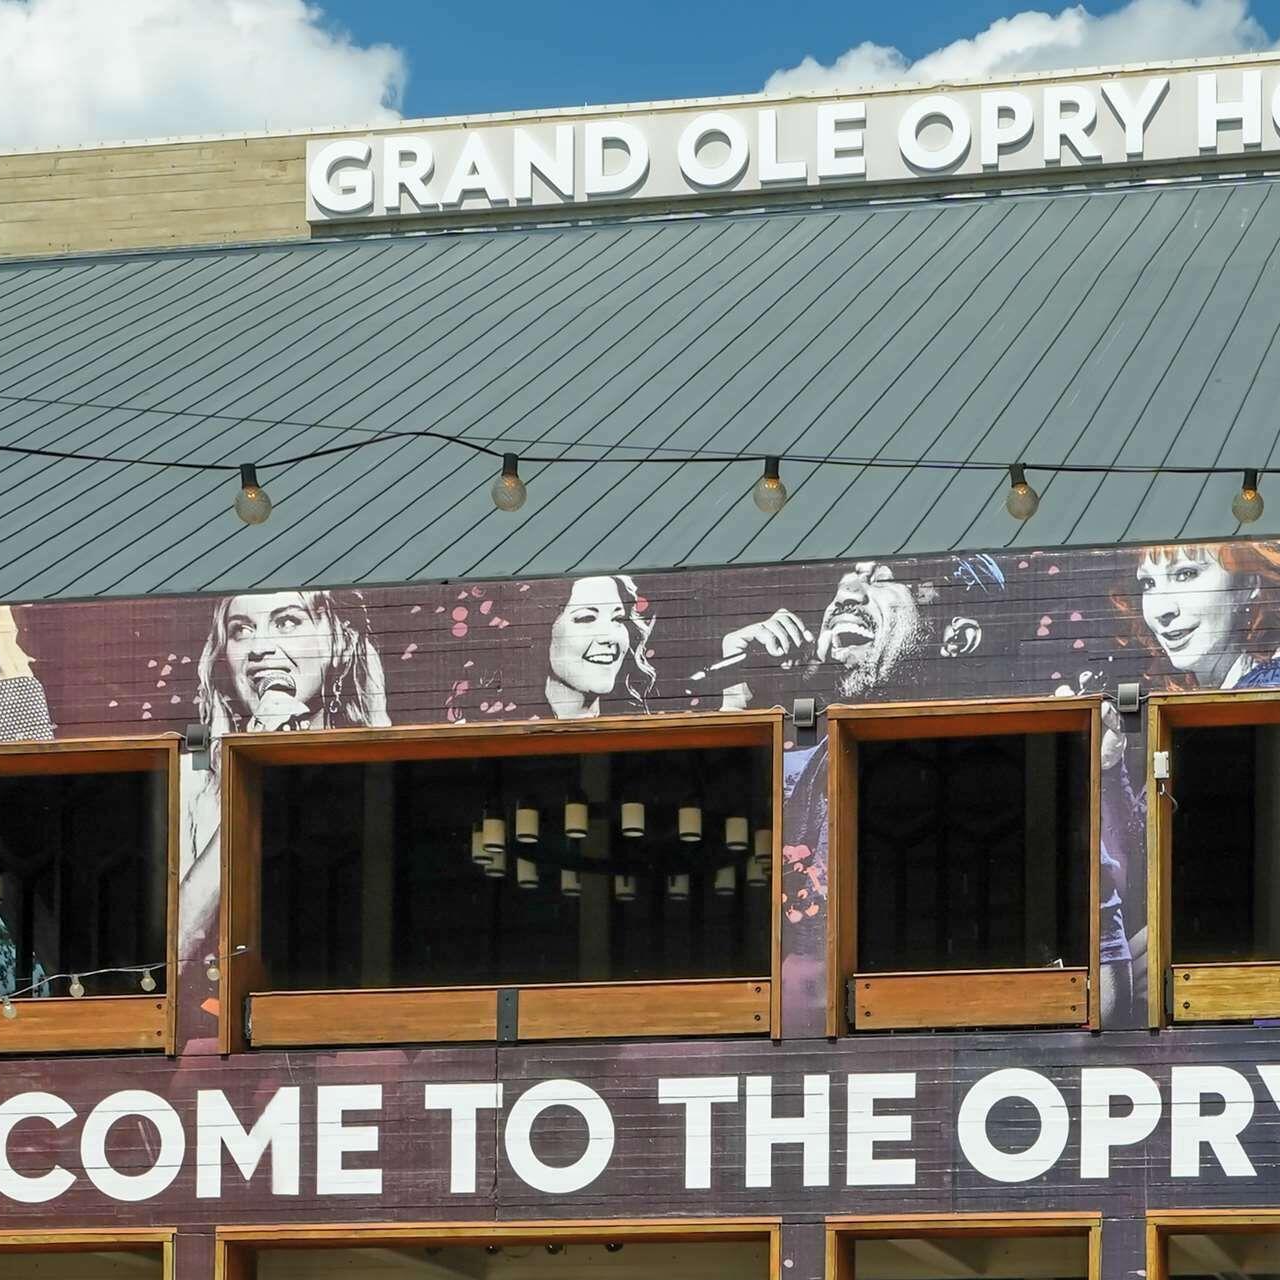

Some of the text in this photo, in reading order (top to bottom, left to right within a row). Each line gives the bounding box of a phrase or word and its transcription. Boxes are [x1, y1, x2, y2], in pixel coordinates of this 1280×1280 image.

[308, 120, 652, 215] GRAND
[676, 102, 868, 187] OLE
[896, 78, 1170, 171] OPRY
[424, 1079, 615, 1194] TO
[658, 1073, 917, 1189] THE
